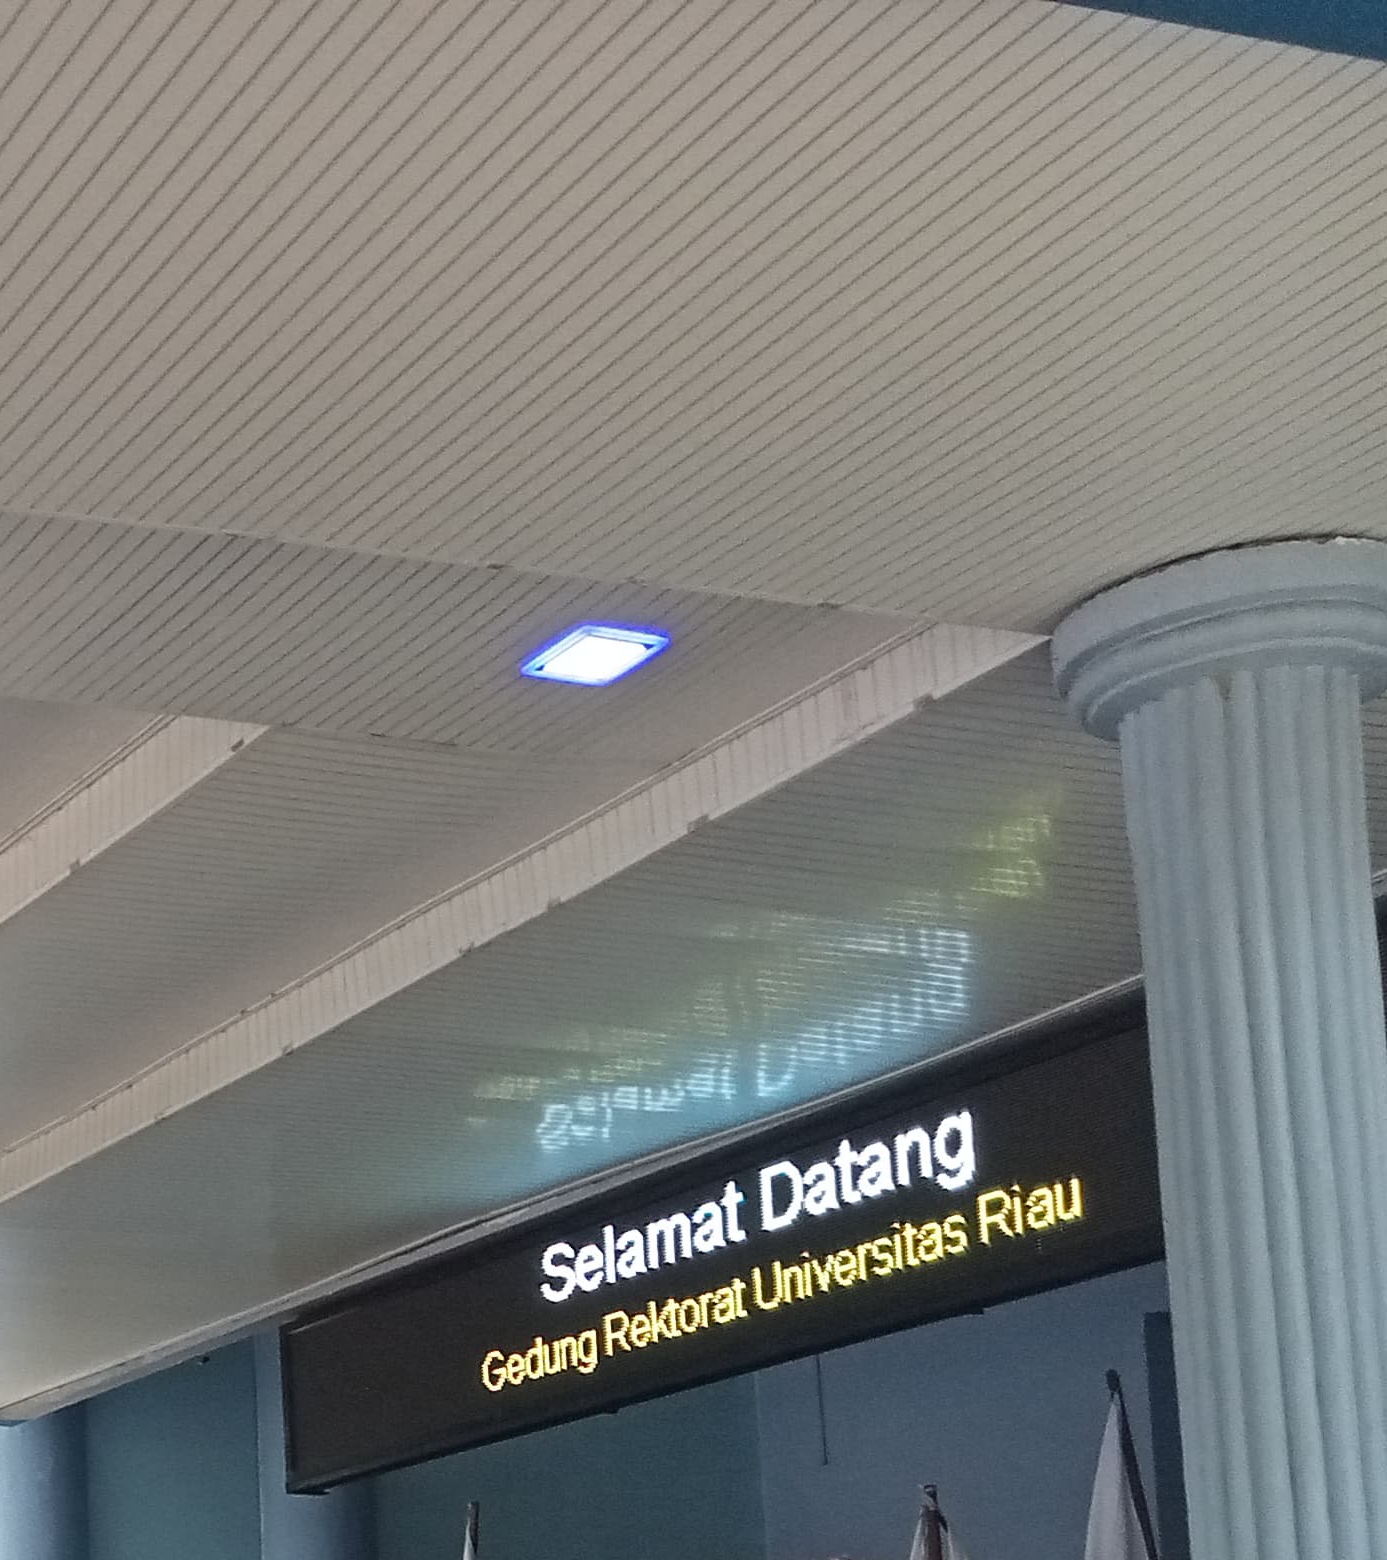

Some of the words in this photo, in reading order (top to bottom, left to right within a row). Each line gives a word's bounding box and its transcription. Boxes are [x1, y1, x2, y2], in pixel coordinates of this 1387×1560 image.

[481, 1327, 599, 1392] Gedung
[602, 1277, 749, 1357] Rektorat
[751, 1213, 969, 1310] Universitas
[976, 1175, 1084, 1245] Riau
[539, 1180, 747, 1303] Selamat
[758, 1108, 978, 1233] Datang
